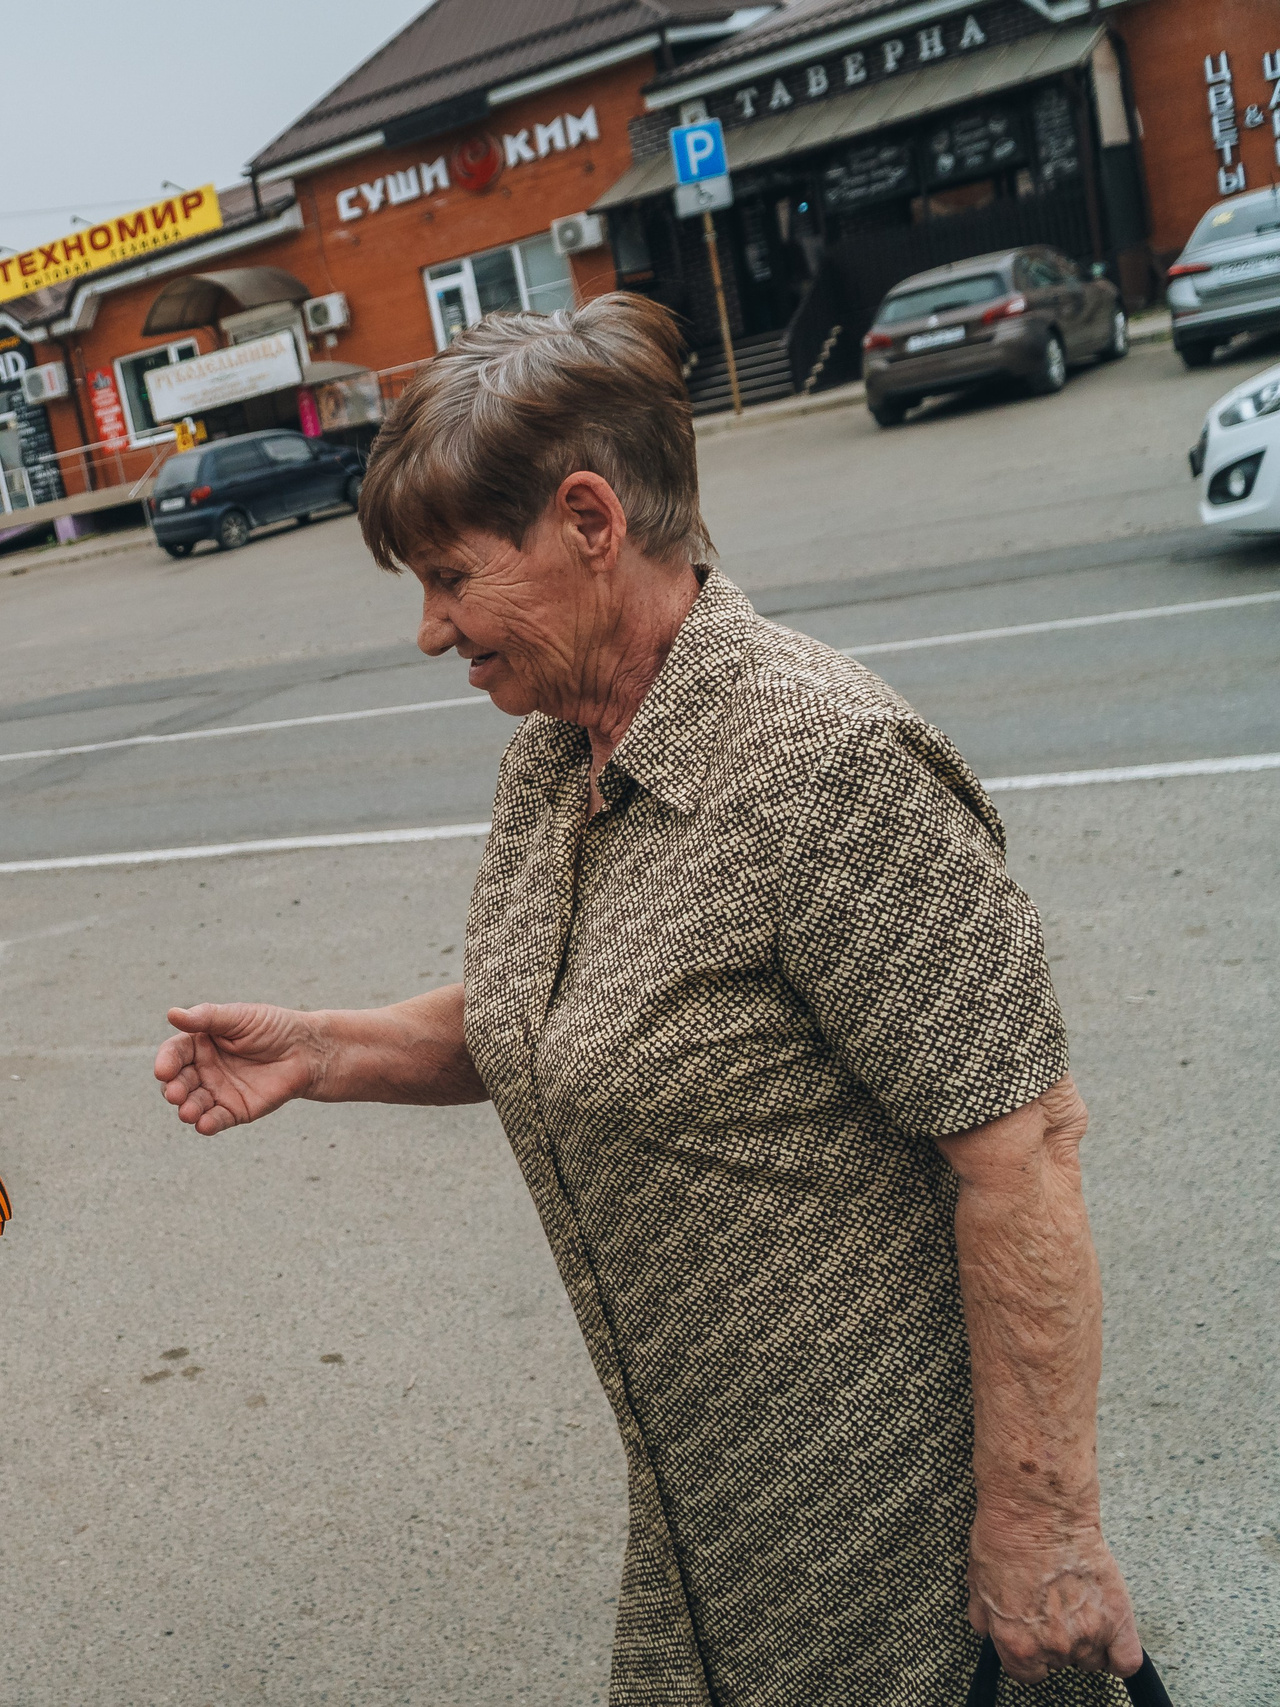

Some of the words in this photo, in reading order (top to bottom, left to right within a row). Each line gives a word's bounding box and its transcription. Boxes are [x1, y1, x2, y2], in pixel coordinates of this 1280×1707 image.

[734, 14, 987, 118] ТАВЕРНА
[336, 155, 450, 222] СУШИ
[502, 105, 600, 168] КИМ
[685, 128, 715, 176] P
[1204, 50, 1246, 195] ЦВЕТЫ
